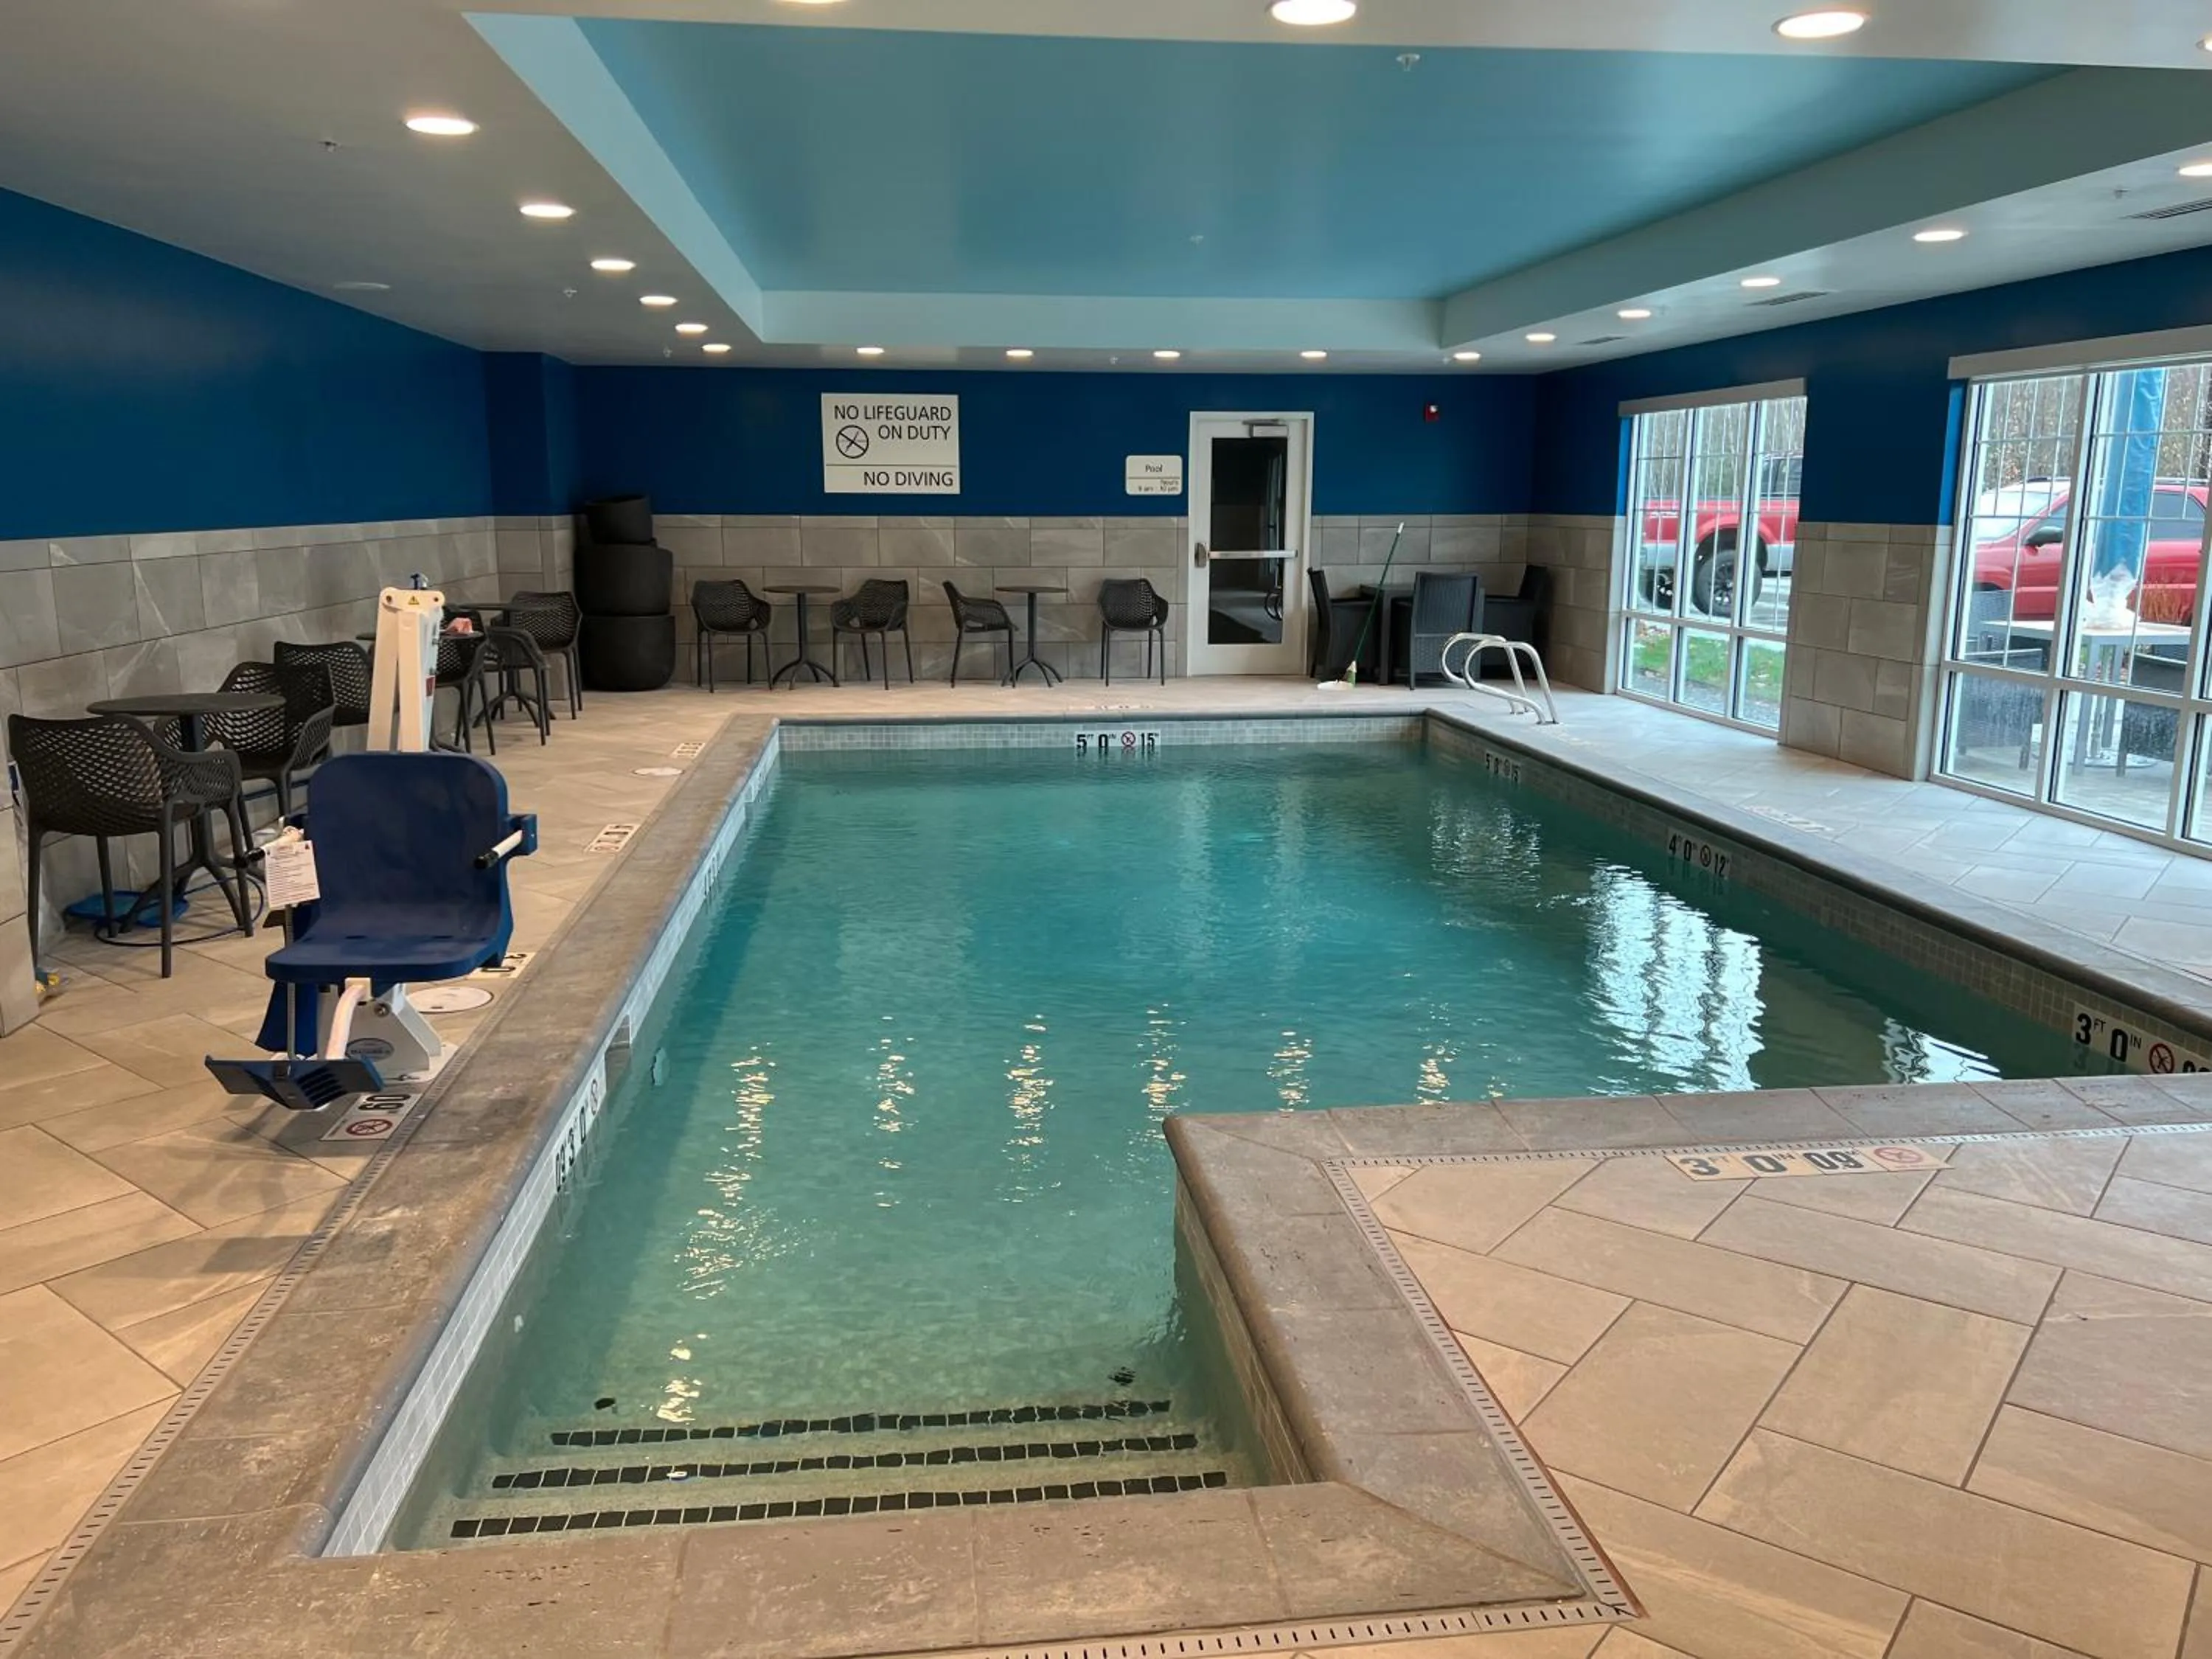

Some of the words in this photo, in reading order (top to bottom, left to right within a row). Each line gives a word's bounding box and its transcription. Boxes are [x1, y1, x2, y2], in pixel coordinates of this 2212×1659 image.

[834, 406, 859, 420] NO
[864, 406, 951, 421] LIFEGUARD
[878, 425, 902, 439] ON
[908, 425, 950, 440] DUTY
[864, 471, 889, 486] NO
[895, 472, 953, 486] DIVING
[1077, 734, 1087, 748] 5
[1098, 734, 1108, 748] 0
[1669, 833, 1677, 855] 4
[1684, 840, 1692, 861] 0
[1715, 853, 1726, 877] 12
[2076, 1013, 2092, 1045] 3
[2093, 1018, 2106, 1032] FT
[2110, 1029, 2128, 1062] 0
[579, 1105, 586, 1145] 0
[1679, 1158, 1720, 1175] 3
[1743, 1155, 1787, 1172] 0
[1803, 1151, 1864, 1169] 09
